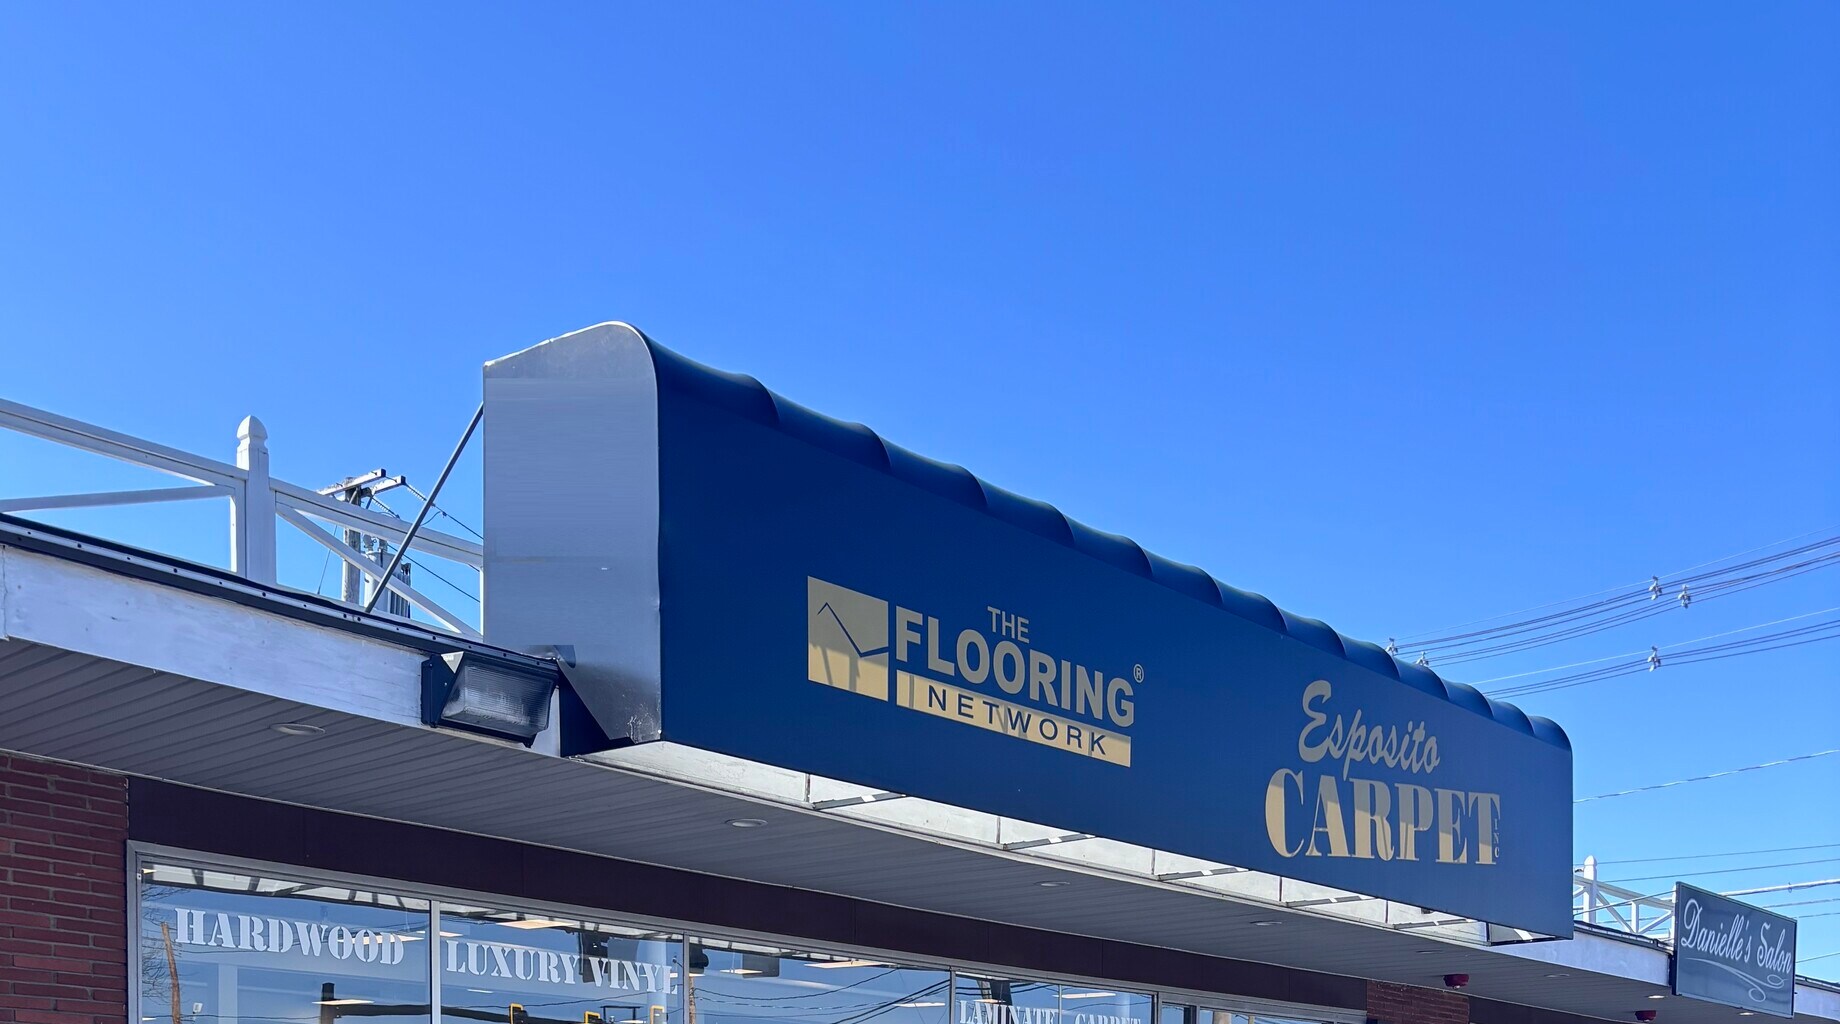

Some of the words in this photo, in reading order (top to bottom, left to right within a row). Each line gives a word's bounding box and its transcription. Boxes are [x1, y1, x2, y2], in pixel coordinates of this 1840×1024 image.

[987, 606, 1030, 644] THE
[896, 605, 1135, 728] FLOORING
[928, 685, 1107, 755] NETWORK
[1298, 679, 1441, 781] Esposito
[1265, 767, 1500, 865] CARPET
[174, 908, 405, 965] HARDWOOD
[446, 939, 580, 985] LUXURY
[588, 956, 678, 995] VINYL
[1680, 898, 1752, 963] Danielle's
[1757, 922, 1792, 974] Salon
